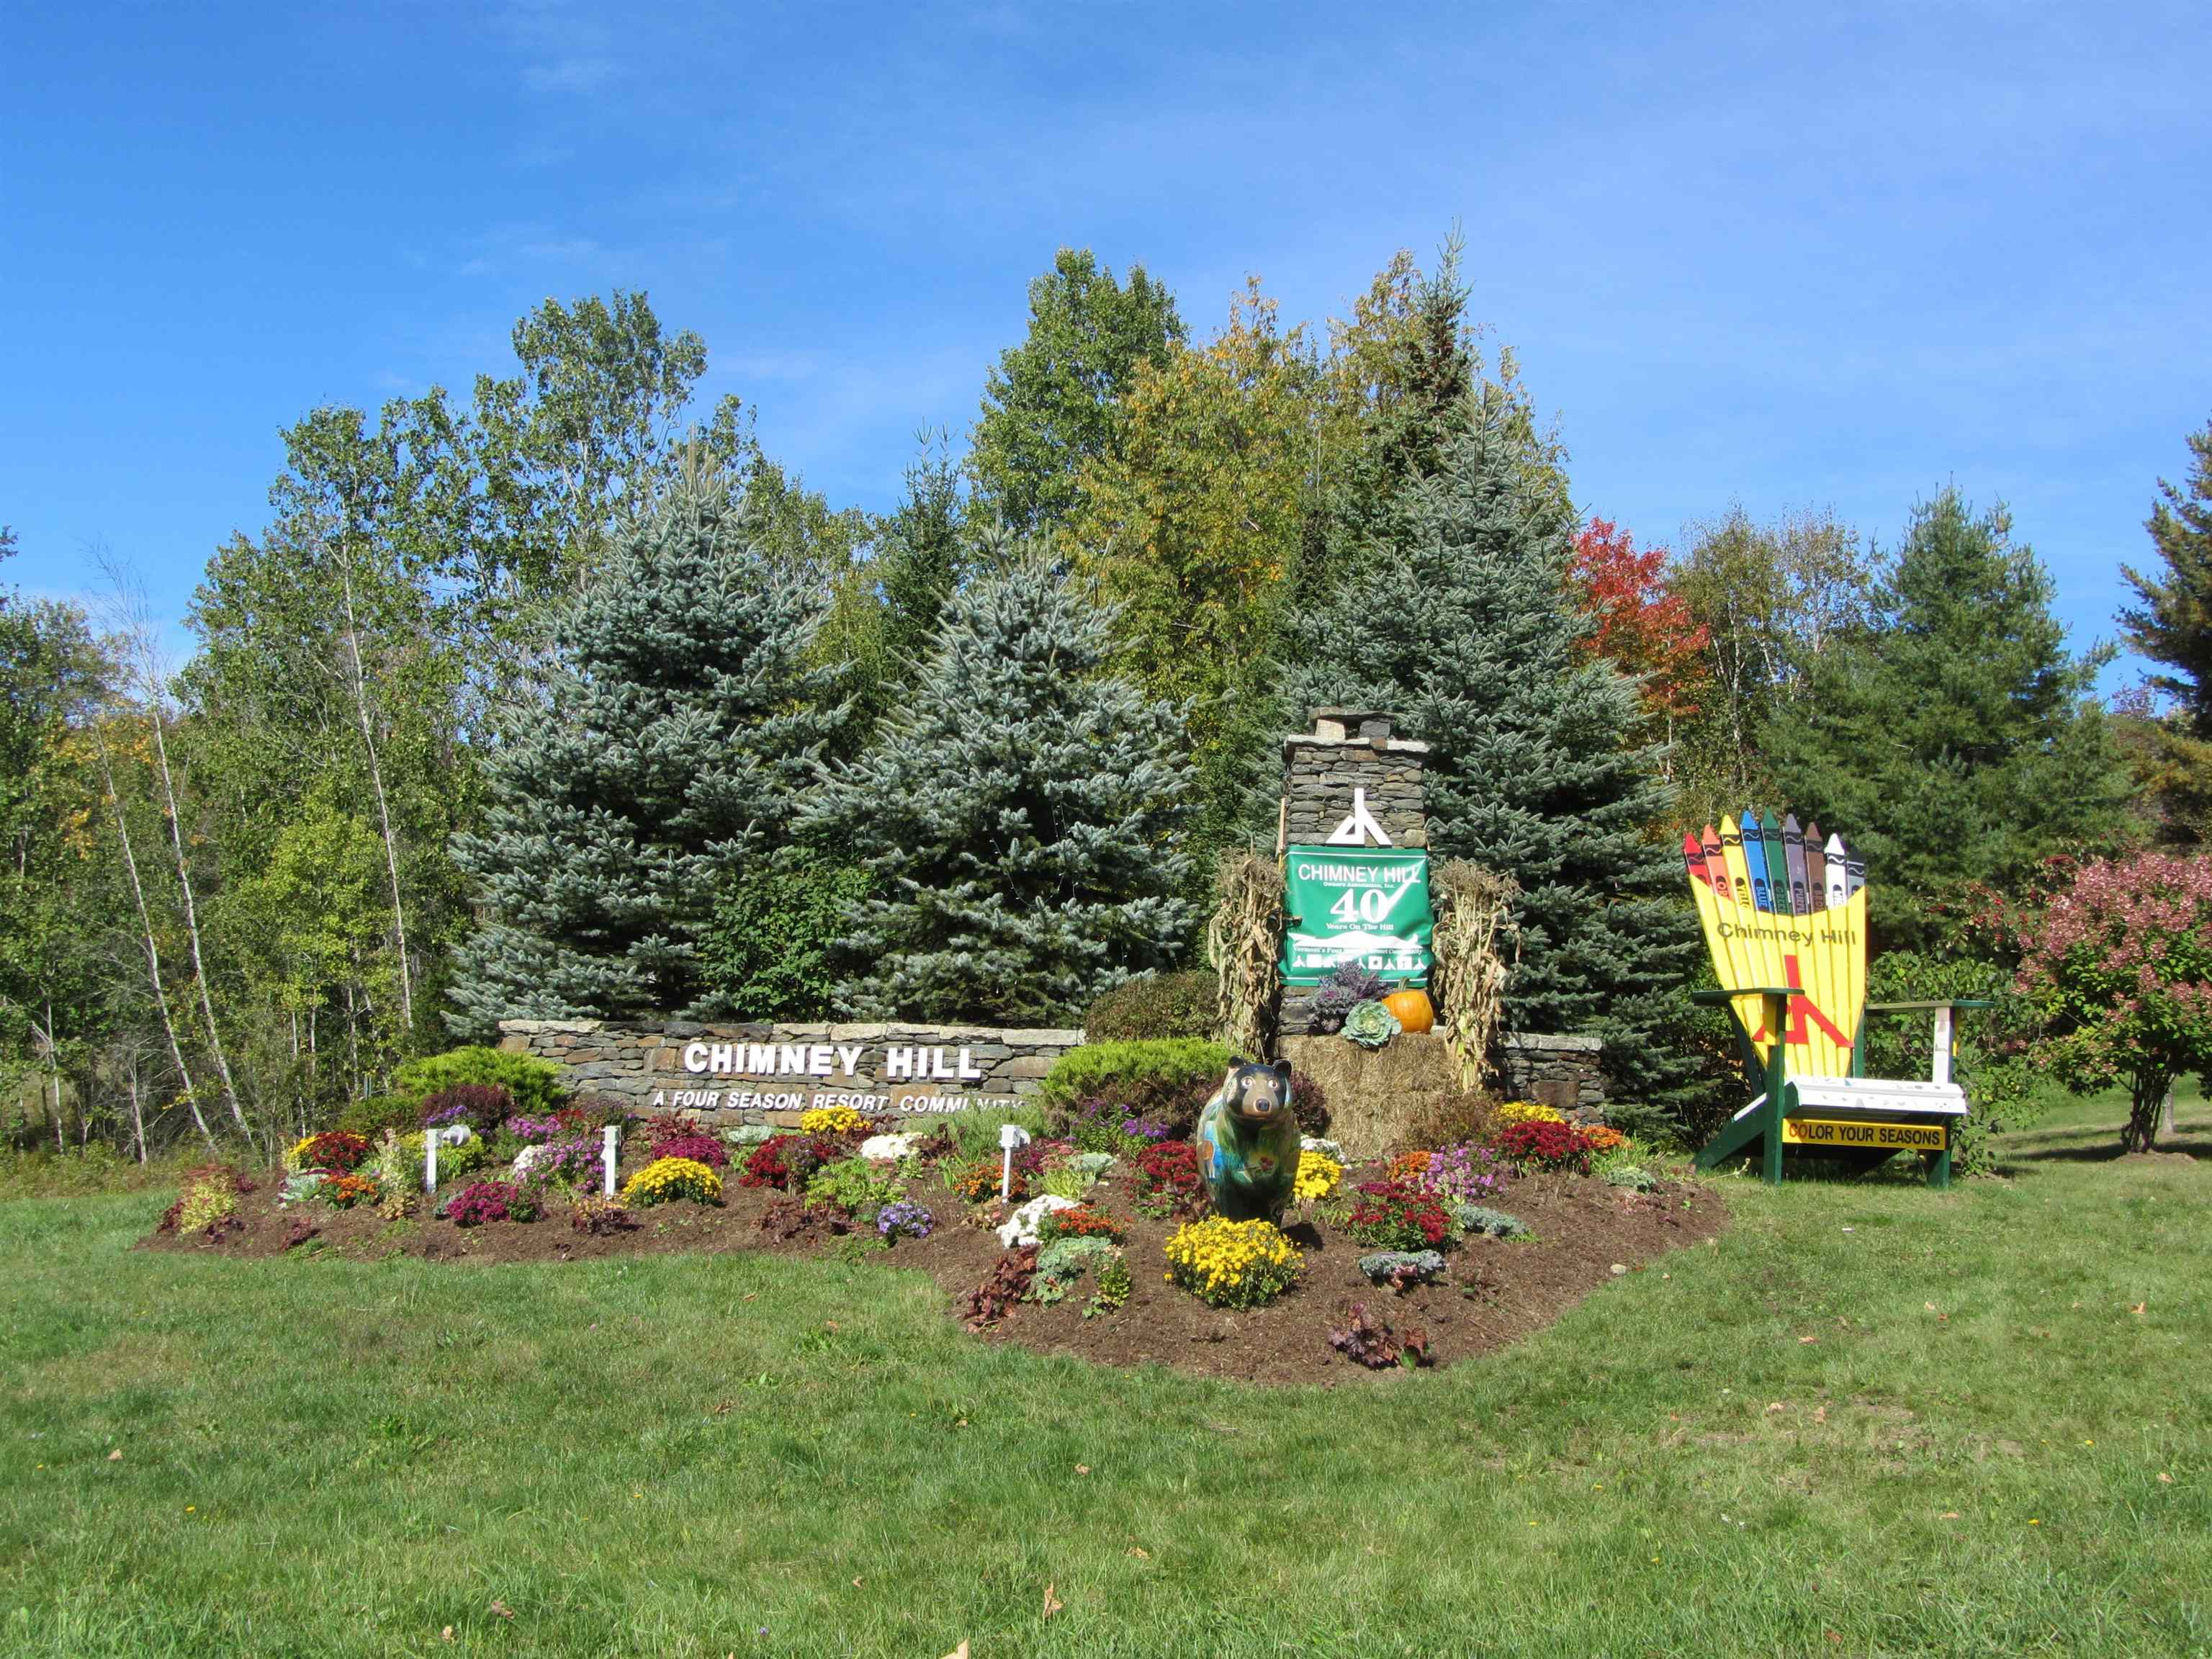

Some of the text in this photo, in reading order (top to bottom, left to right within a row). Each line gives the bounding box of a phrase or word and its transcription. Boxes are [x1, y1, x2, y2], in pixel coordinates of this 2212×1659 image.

[1298, 864, 1421, 884] CHIMNEY HILL
[1330, 888, 1390, 923] 40
[1756, 886, 1769, 910] BLUE
[1717, 922, 1856, 947] Chimney Hill
[684, 1042, 981, 1079] CHIMNEY HILL
[653, 1092, 665, 1107] A
[672, 1091, 719, 1109] FOUR
[727, 1092, 804, 1110] SEASON
[812, 1094, 889, 1112] RESORT
[1789, 1123, 1940, 1146] COLOR YOUR SEASONS
